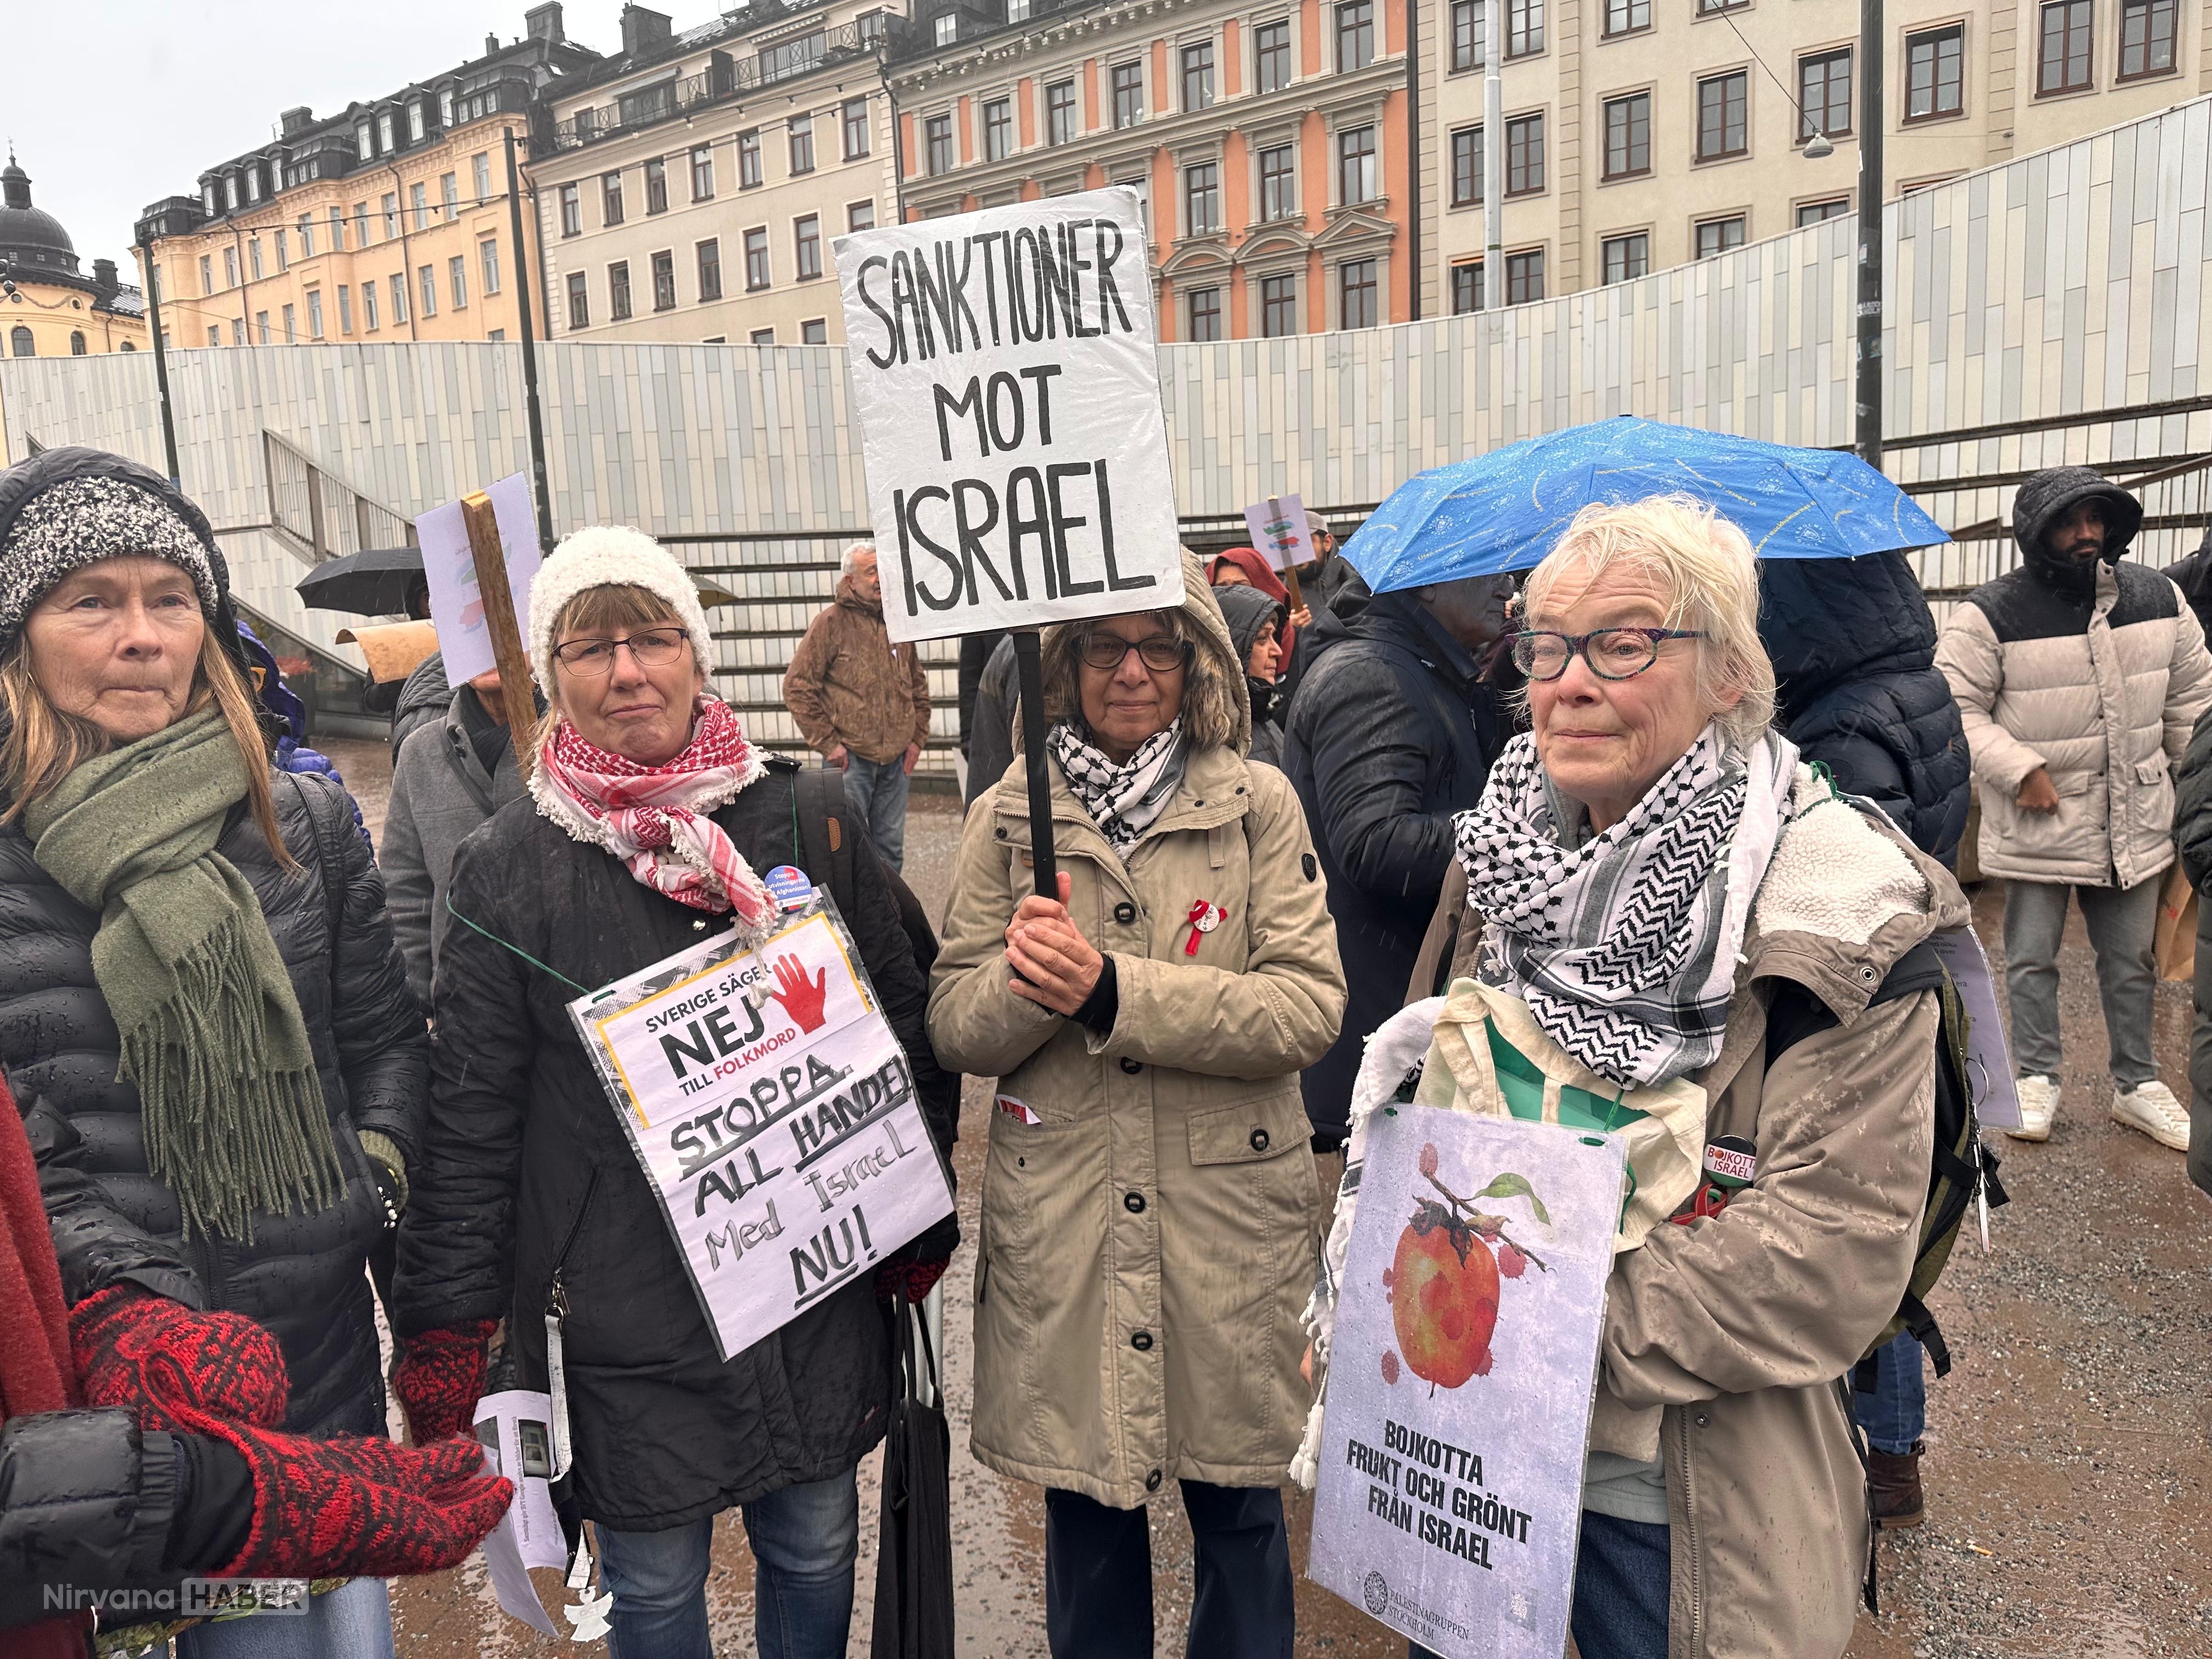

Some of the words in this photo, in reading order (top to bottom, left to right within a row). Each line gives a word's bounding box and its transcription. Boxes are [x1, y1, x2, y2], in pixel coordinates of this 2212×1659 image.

[857, 218, 1132, 369] SANKTIONER
[933, 364, 1062, 461] MOT
[893, 459, 1157, 617] ISRAEL
[769, 878, 805, 889] utvisningarna
[776, 884, 810, 895] Afghanistan!
[646, 988, 718, 1033] SVERIGE
[659, 995, 764, 1080] NEJ
[679, 1074, 713, 1097] TILL
[714, 1028, 796, 1080] FOLKMORD
[671, 1054, 839, 1166] STOPPA
[695, 1147, 784, 1218] ALL
[789, 1054, 912, 1159] HANDEL
[1714, 1160, 1748, 1178] ISRAEL
[706, 1197, 786, 1271] Med
[789, 1204, 878, 1295] NU!
[1347, 1438, 1401, 1487] FRUKT
[1405, 1468, 1445, 1510] OCH
[1452, 1487, 1532, 1544] GRÖNT
[1384, 1419, 1483, 1487] BOJKOTTA
[1368, 1485, 1413, 1533] FRÅN
[1418, 1511, 1492, 1571] ISRAEL
[1389, 1605, 1434, 1640] STOCKHOLM
[1390, 1589, 1469, 1640] PALESTINAGRUPPEN
